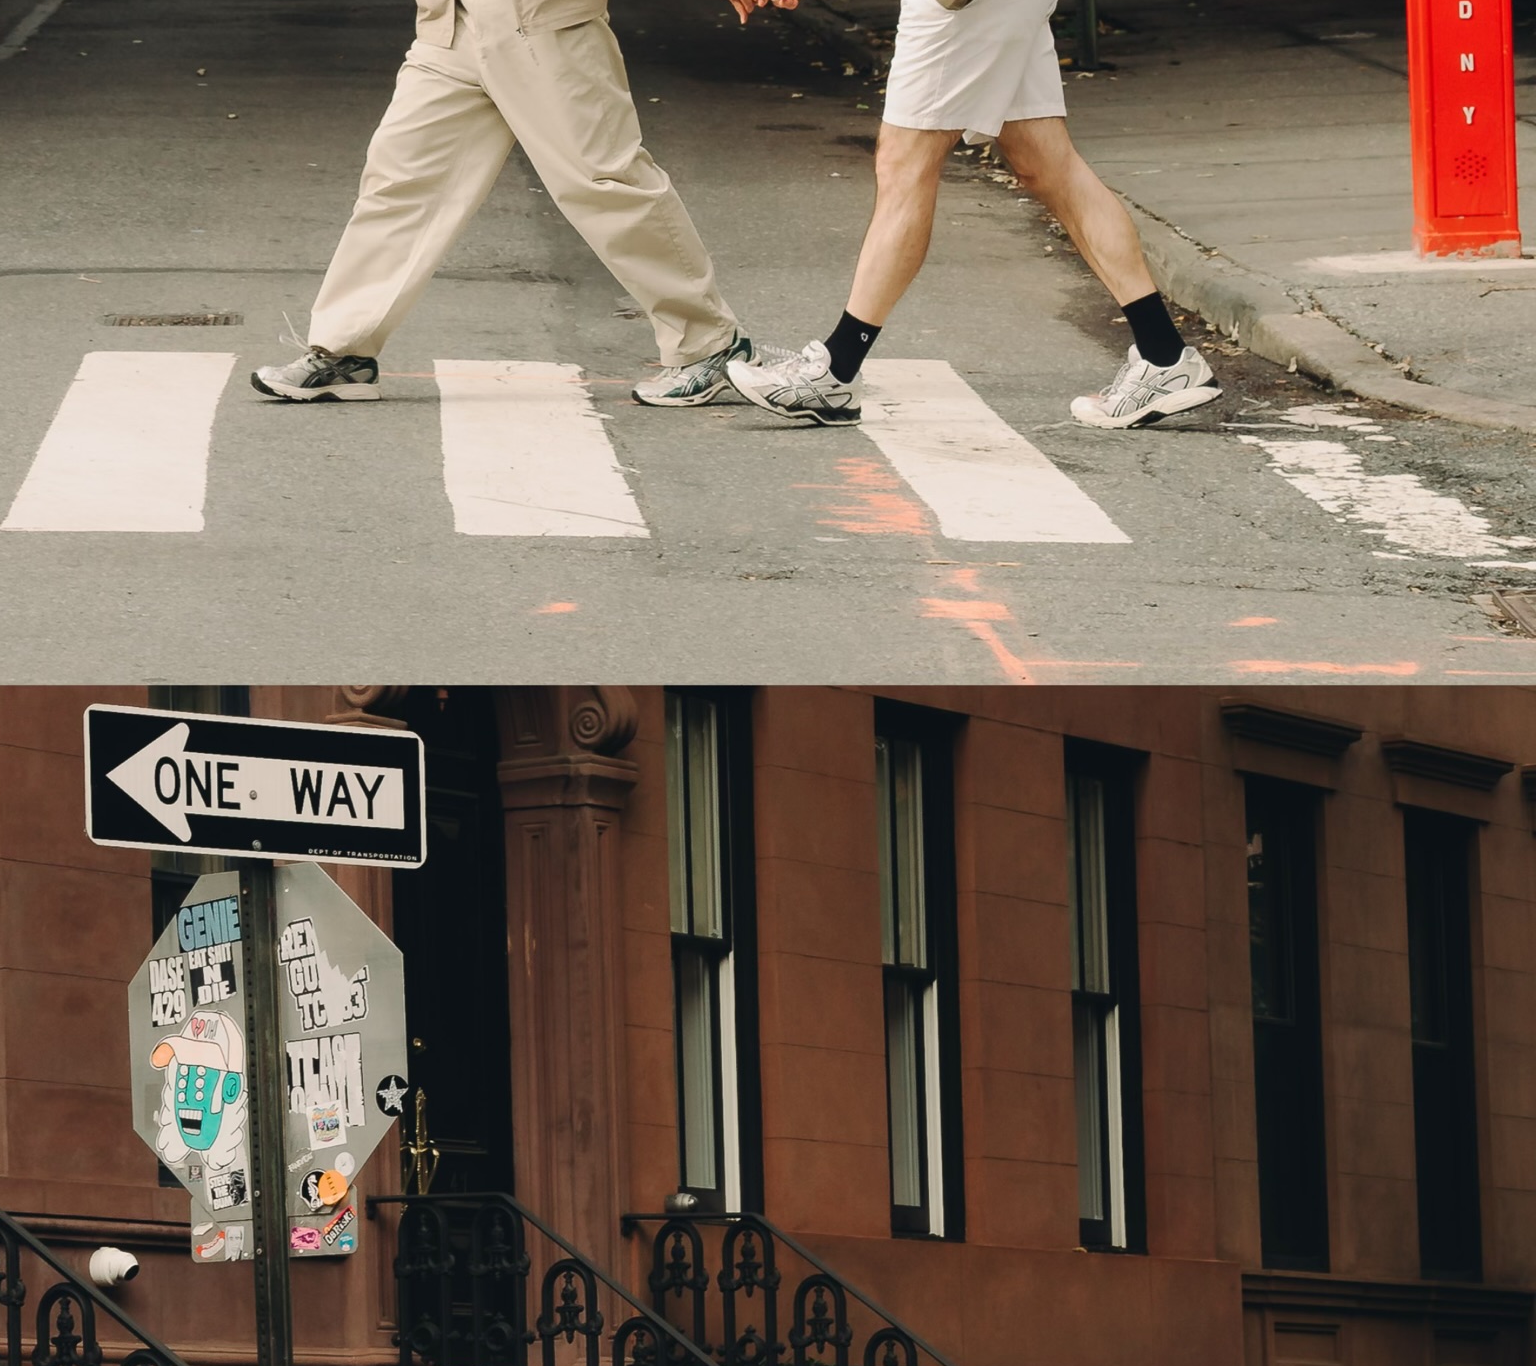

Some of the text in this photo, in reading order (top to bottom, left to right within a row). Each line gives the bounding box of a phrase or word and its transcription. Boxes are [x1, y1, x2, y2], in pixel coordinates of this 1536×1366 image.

[154, 756, 385, 820] ONE WAY
[346, 851, 418, 861] TRANSPORTATION
[178, 896, 241, 952] GENIE
[188, 942, 232, 969] EAT SHIT
[149, 956, 184, 994] DASE
[203, 963, 222, 985] N
[198, 980, 233, 1006] DIE
[152, 989, 186, 1026] 429
[209, 1173, 231, 1189] STEVE
[214, 1185, 229, 1198] THE
